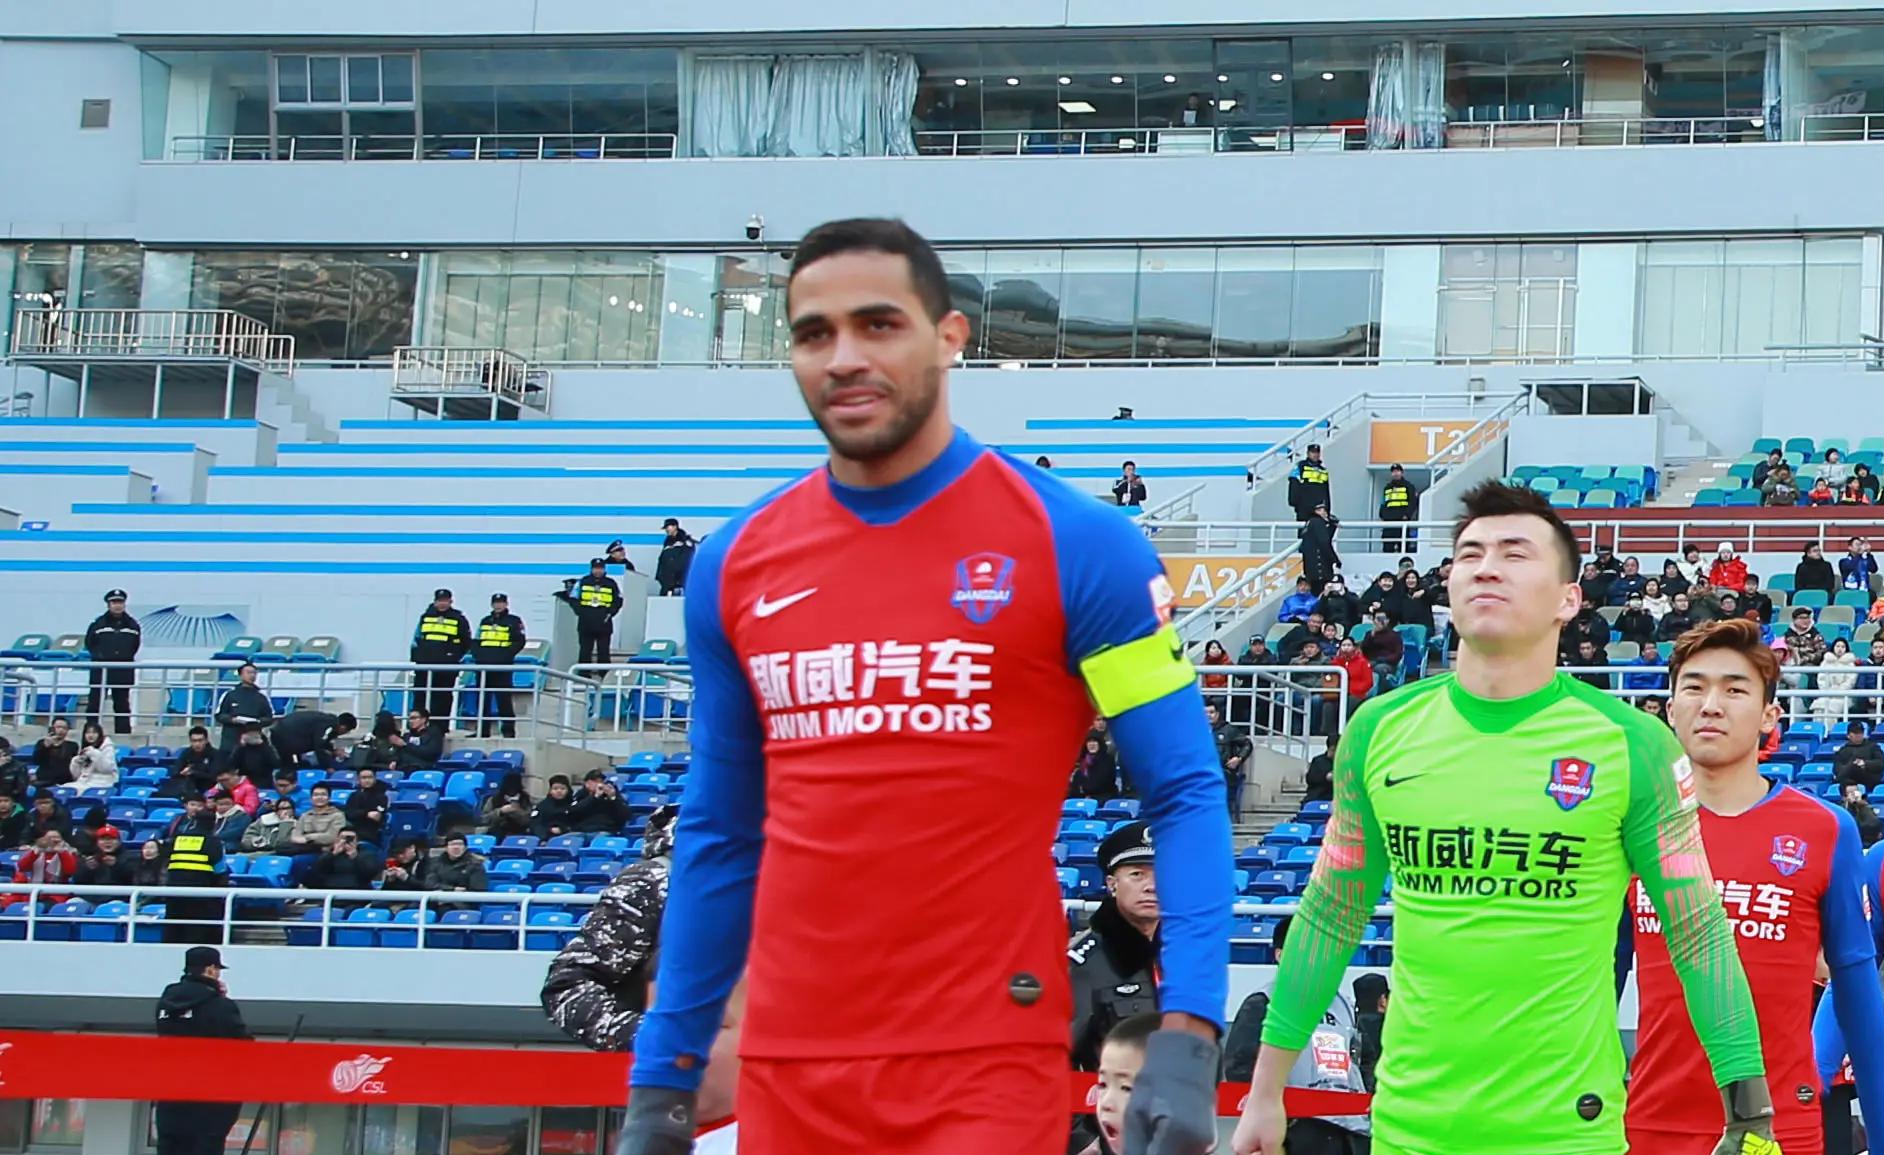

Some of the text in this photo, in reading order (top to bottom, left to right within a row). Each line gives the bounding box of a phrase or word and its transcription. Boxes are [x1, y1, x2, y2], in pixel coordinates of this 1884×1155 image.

[749, 638, 995, 711] 斯威汽车
[827, 703, 993, 736] MOTORS
[1387, 824, 1587, 876] 斯威汽车
[1400, 871, 1578, 900] WM MOTORS
[1637, 916, 1787, 942] SW TORS
[362, 1081, 388, 1094] CSL
